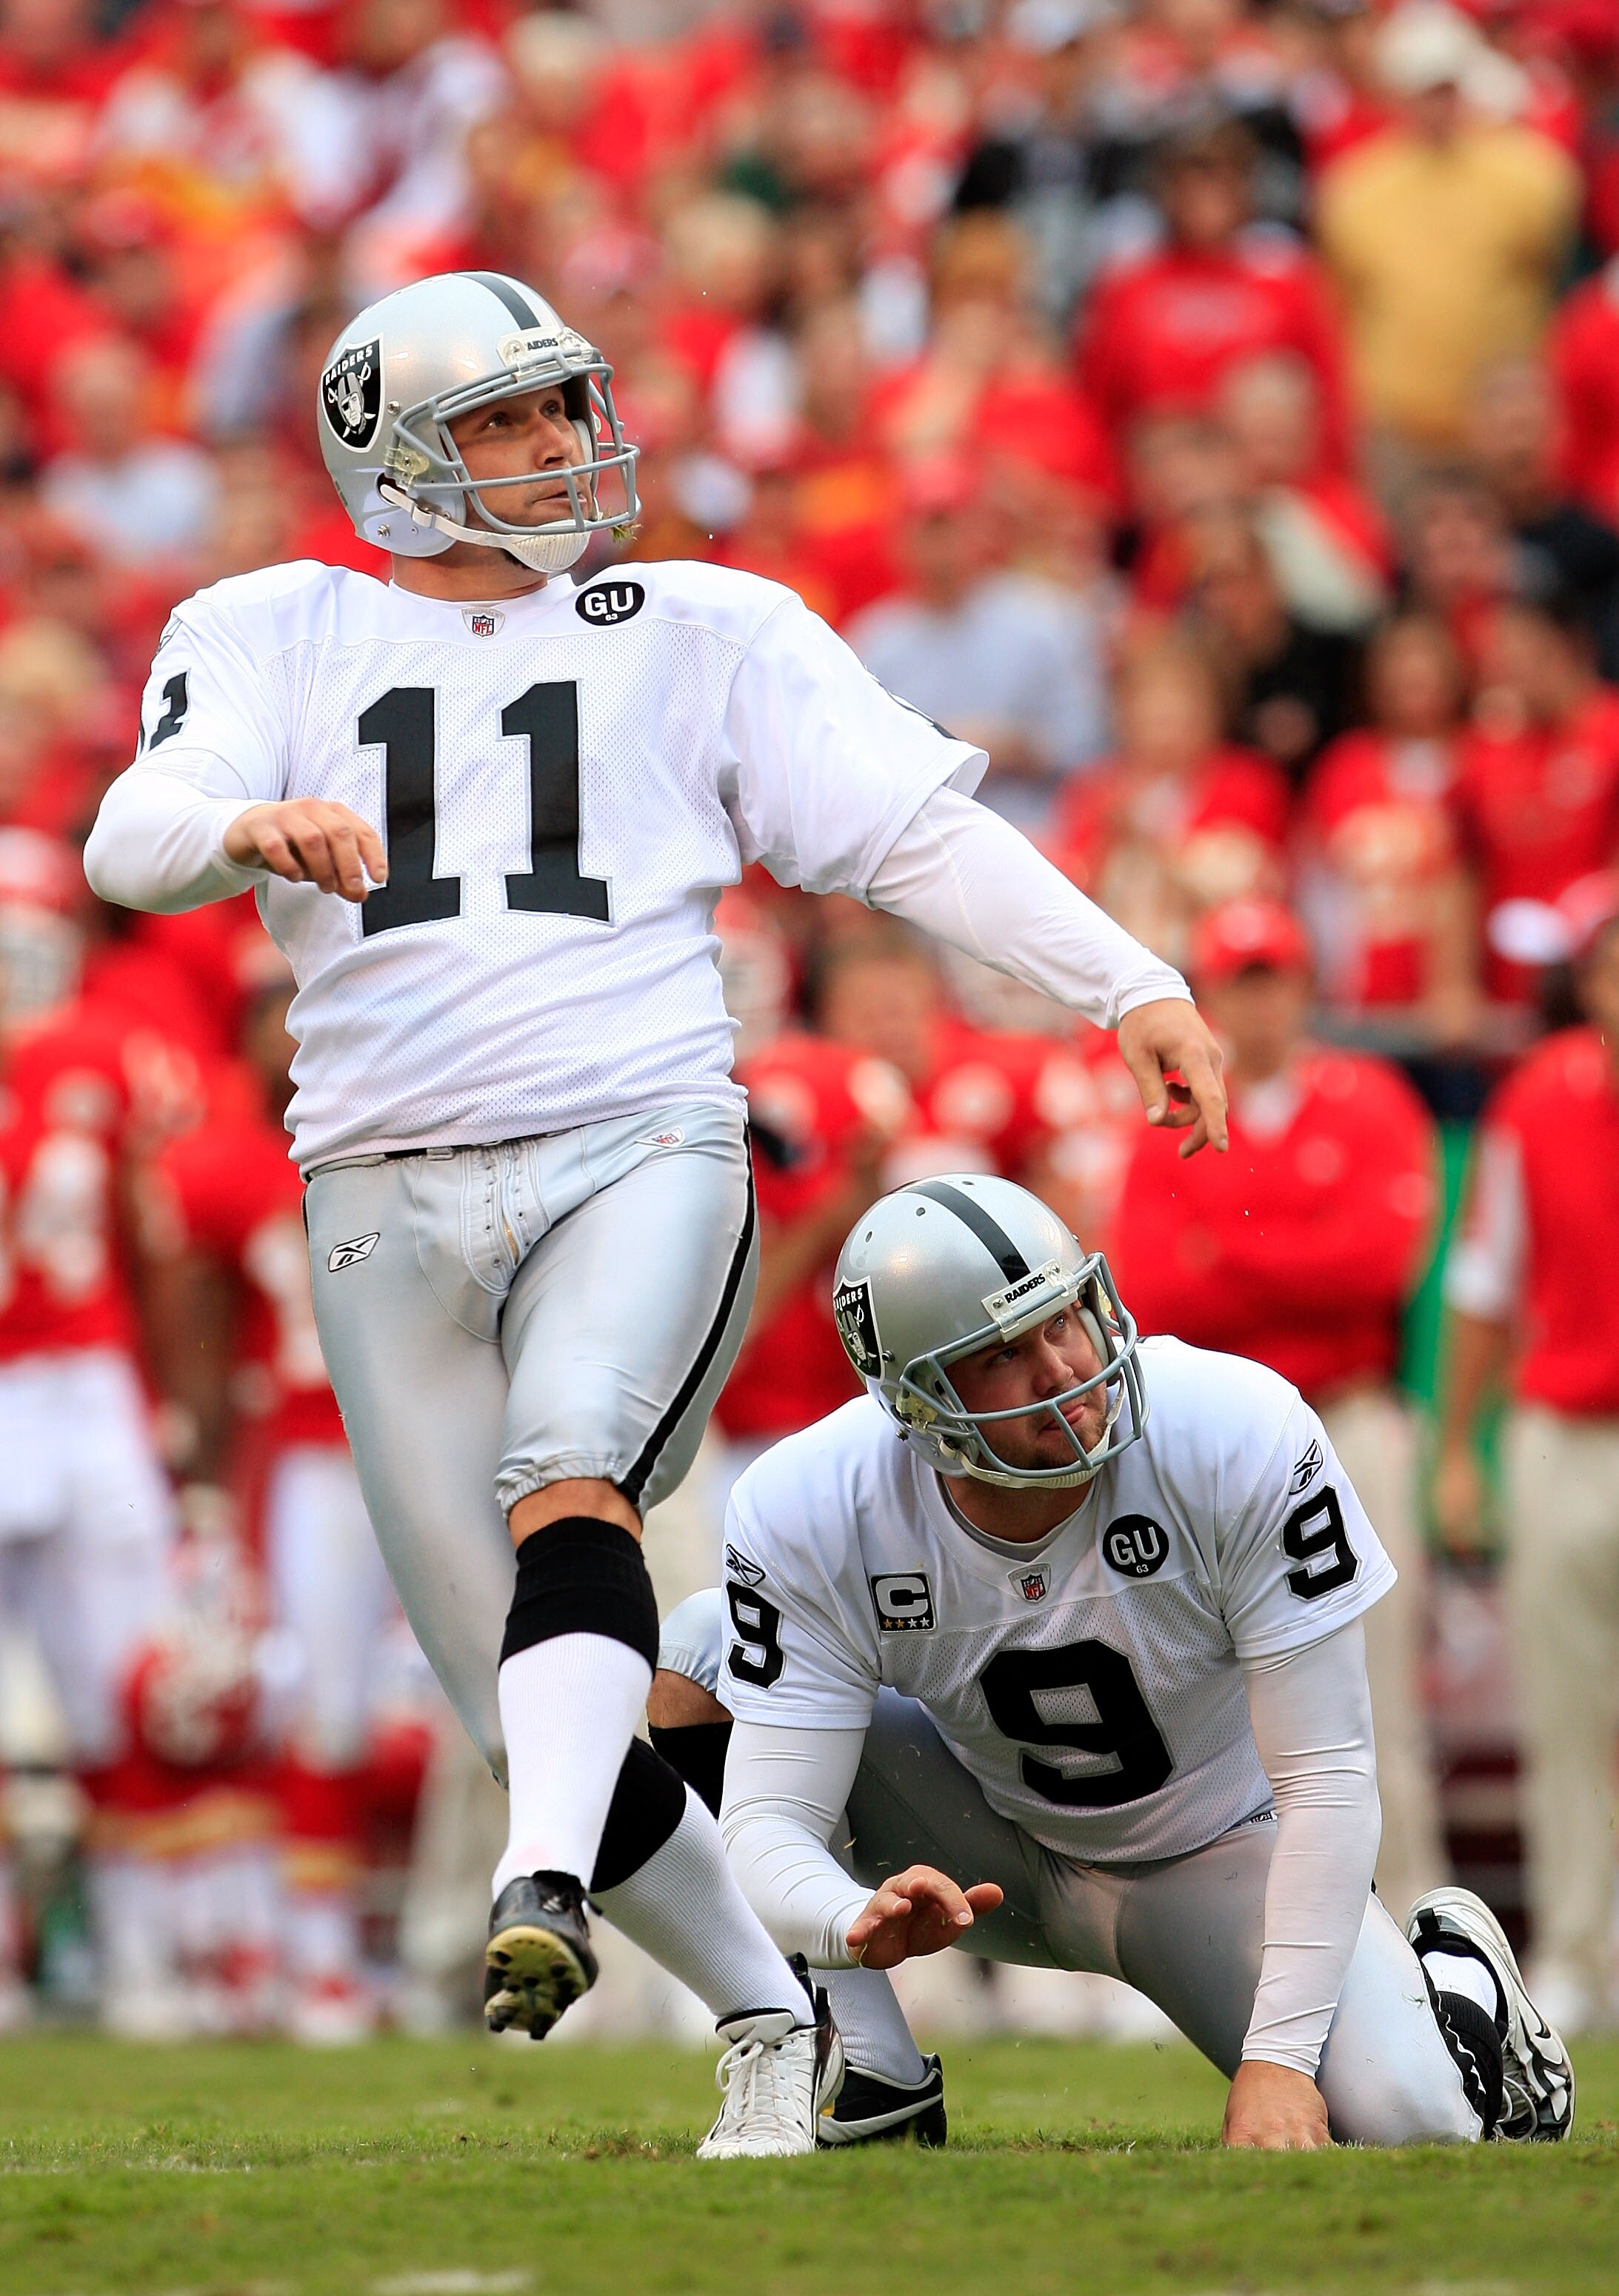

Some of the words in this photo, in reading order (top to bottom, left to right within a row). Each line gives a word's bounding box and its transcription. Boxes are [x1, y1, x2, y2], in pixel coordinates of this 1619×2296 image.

[527, 338, 558, 350] AIDERS
[325, 345, 373, 386] RAIDERS
[584, 587, 634, 617] GU
[474, 623, 493, 635] NFL
[358, 680, 610, 938] 11
[1004, 1273, 1046, 1304] RAIDERS
[1110, 1526, 1160, 1565] GU
[1281, 1483, 1361, 1602] 9
[1136, 1564, 1149, 1573] 63
[875, 1577, 929, 1618] C
[1025, 1583, 1044, 1598] NFL
[725, 1580, 786, 1690] 9
[978, 1638, 1173, 1807] 9
